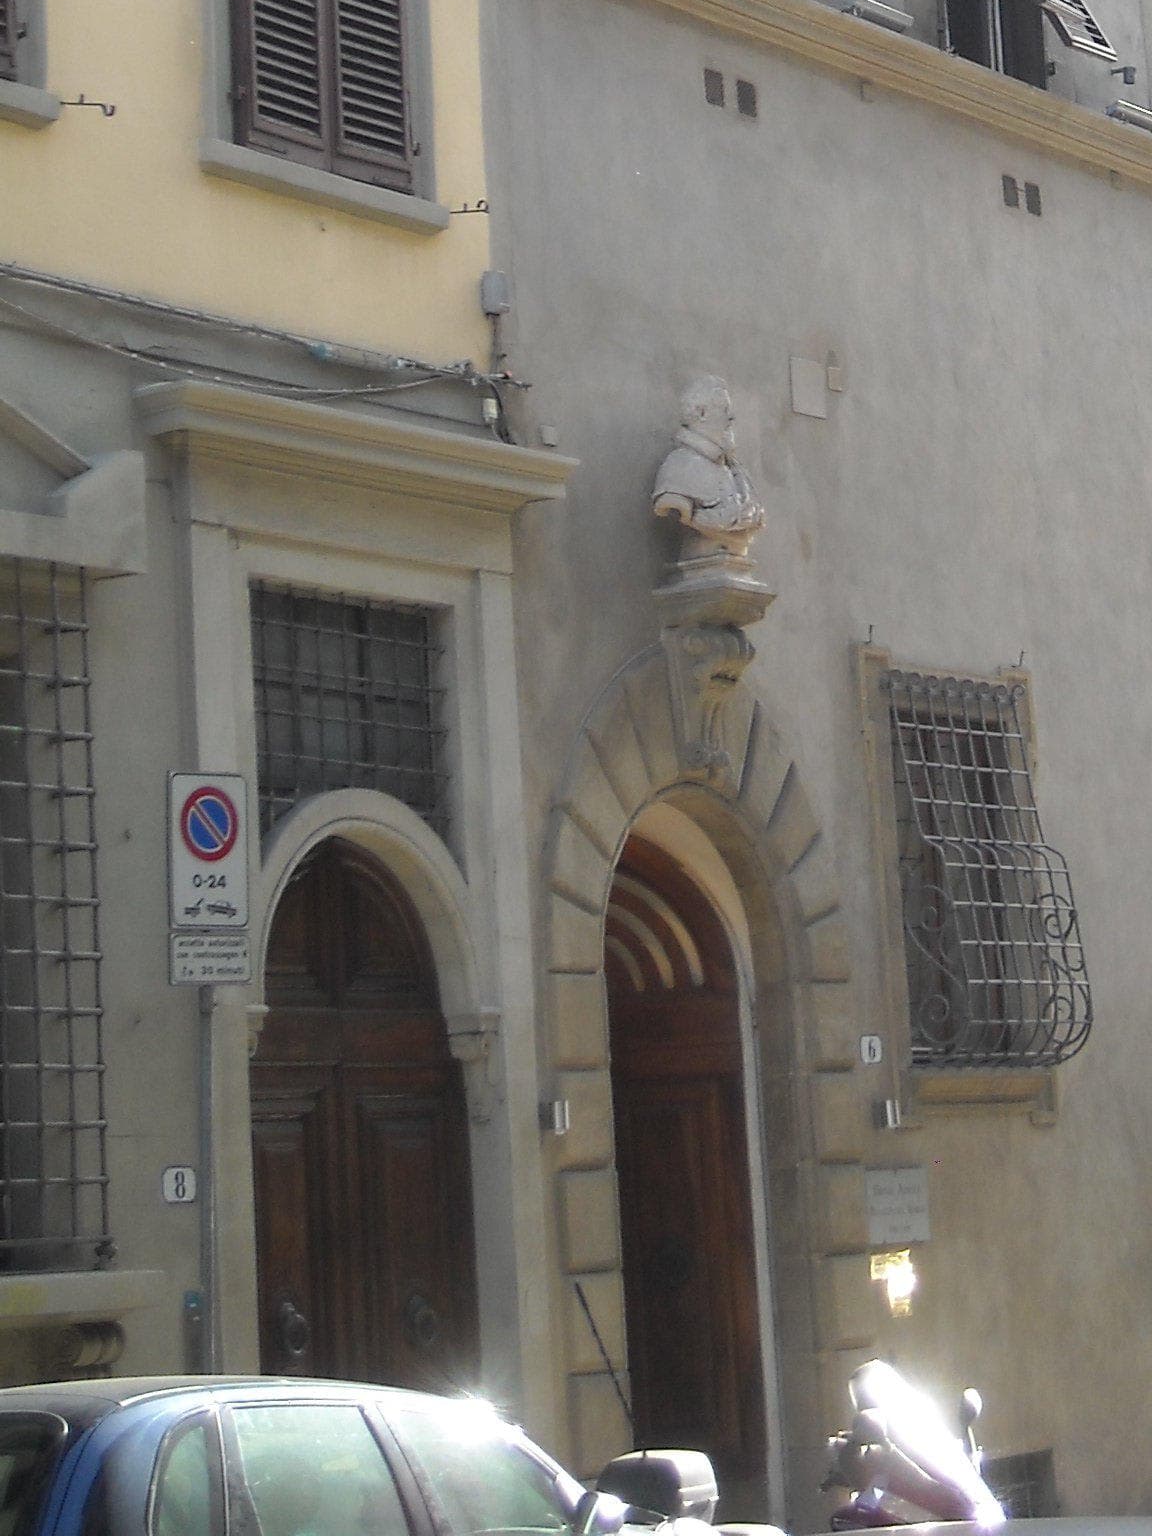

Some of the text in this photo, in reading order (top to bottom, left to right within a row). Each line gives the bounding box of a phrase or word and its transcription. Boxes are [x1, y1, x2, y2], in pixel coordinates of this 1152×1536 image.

[192, 874, 227, 888] 0-24
[868, 1038, 877, 1061] 6
[175, 1171, 186, 1199] 8
